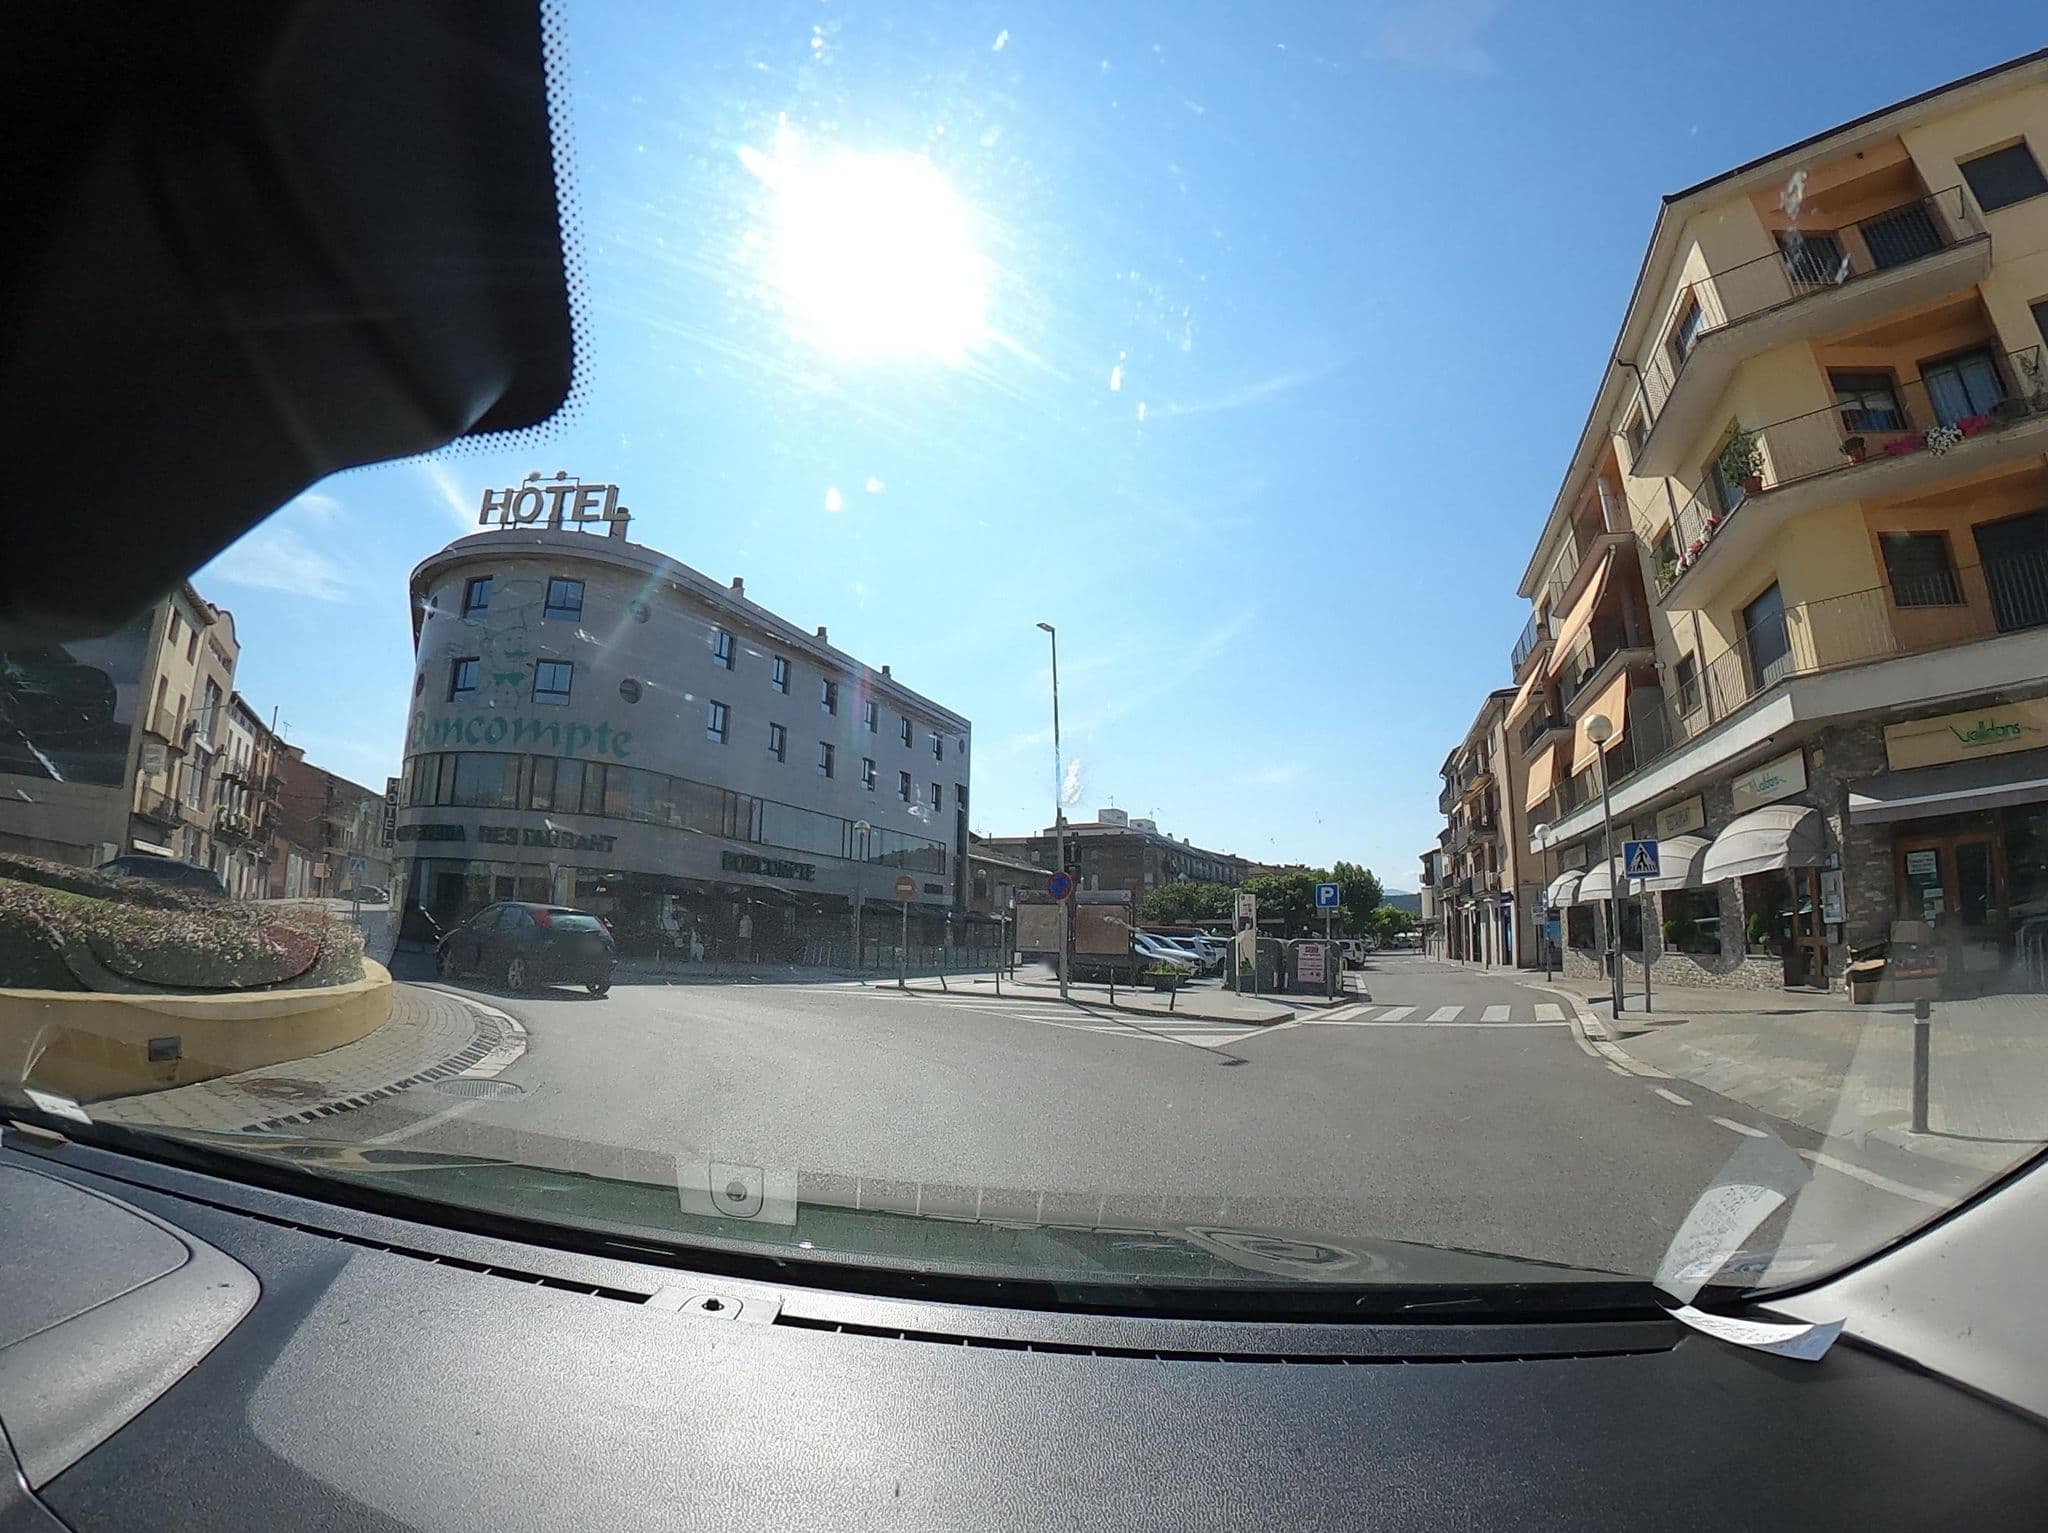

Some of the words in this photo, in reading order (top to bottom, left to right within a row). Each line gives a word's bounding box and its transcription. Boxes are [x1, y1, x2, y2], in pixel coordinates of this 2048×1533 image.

[479, 484, 631, 525] HOTEL
[383, 779, 400, 842] HOTEL
[1320, 886, 1334, 905] P
